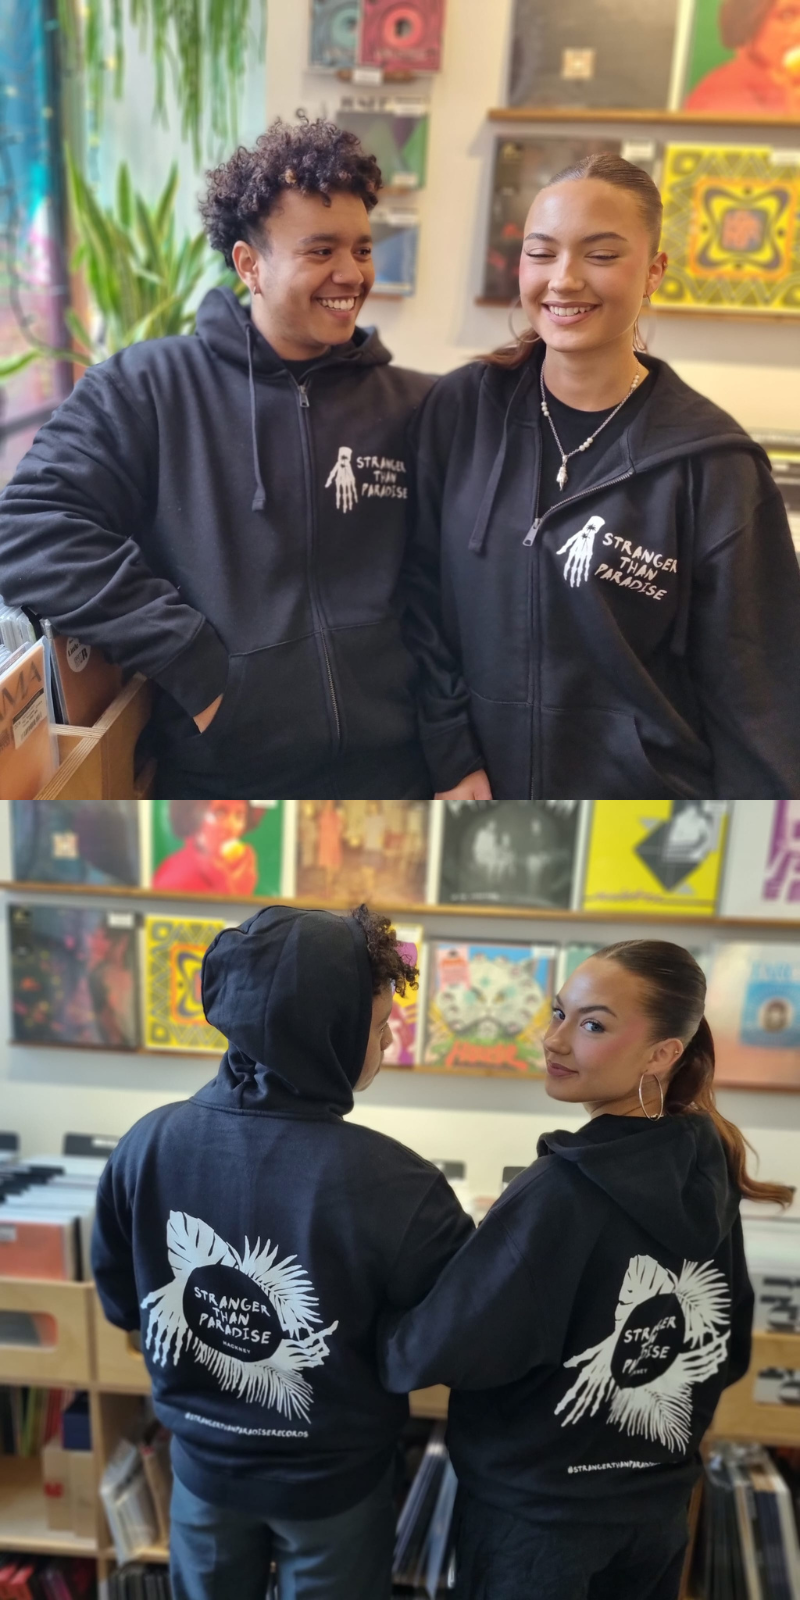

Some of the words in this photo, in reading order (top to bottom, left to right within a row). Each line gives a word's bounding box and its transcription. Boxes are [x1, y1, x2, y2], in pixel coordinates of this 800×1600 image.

[356, 455, 406, 473] STRANGER
[373, 470, 397, 483] THAN
[361, 482, 408, 499] PARADISE
[602, 532, 678, 573] STRANGER
[620, 556, 658, 581] THAN
[594, 563, 667, 600] PARADISE
[193, 1286, 271, 1317] STRANGER
[212, 1306, 250, 1326] THAN
[199, 1312, 272, 1344] PARADISE
[222, 1340, 251, 1354] HACKNEY
